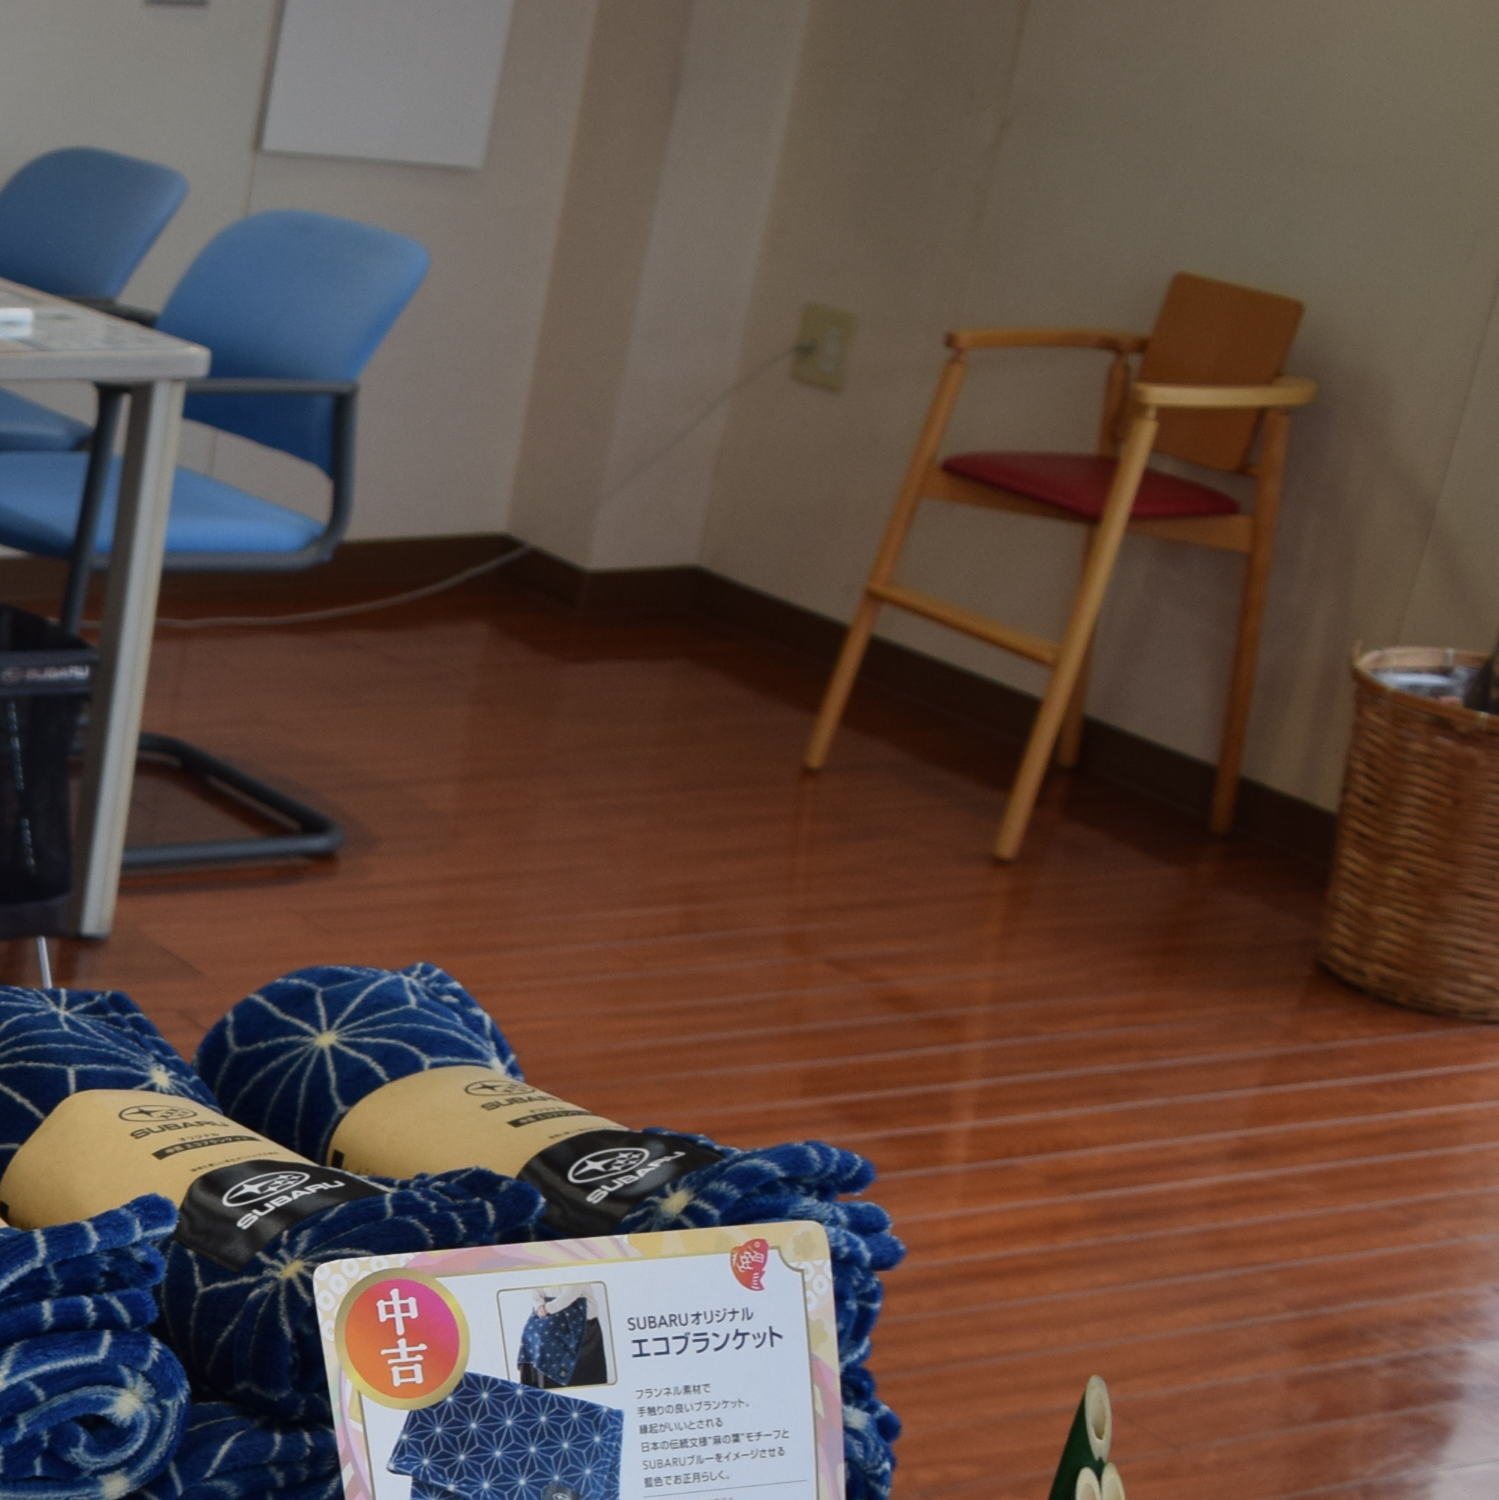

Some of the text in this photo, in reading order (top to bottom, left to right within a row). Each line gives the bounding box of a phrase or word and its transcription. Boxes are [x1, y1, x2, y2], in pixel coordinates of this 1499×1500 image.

[130, 1120, 230, 1140] SUBARU
[586, 1151, 687, 1205] SUBARU
[236, 1180, 346, 1230] SUBARU
[627, 1306, 754, 1332] SUBARUオリジナル
[376, 1288, 428, 1388] 中吉
[630, 1329, 784, 1360] エコブランケット
[635, 1383, 711, 1400] フランネル素材で
[639, 1417, 724, 1435] 縁起がいいとされる
[642, 1446, 786, 1471] SUBARUブルーをイメージさせる
